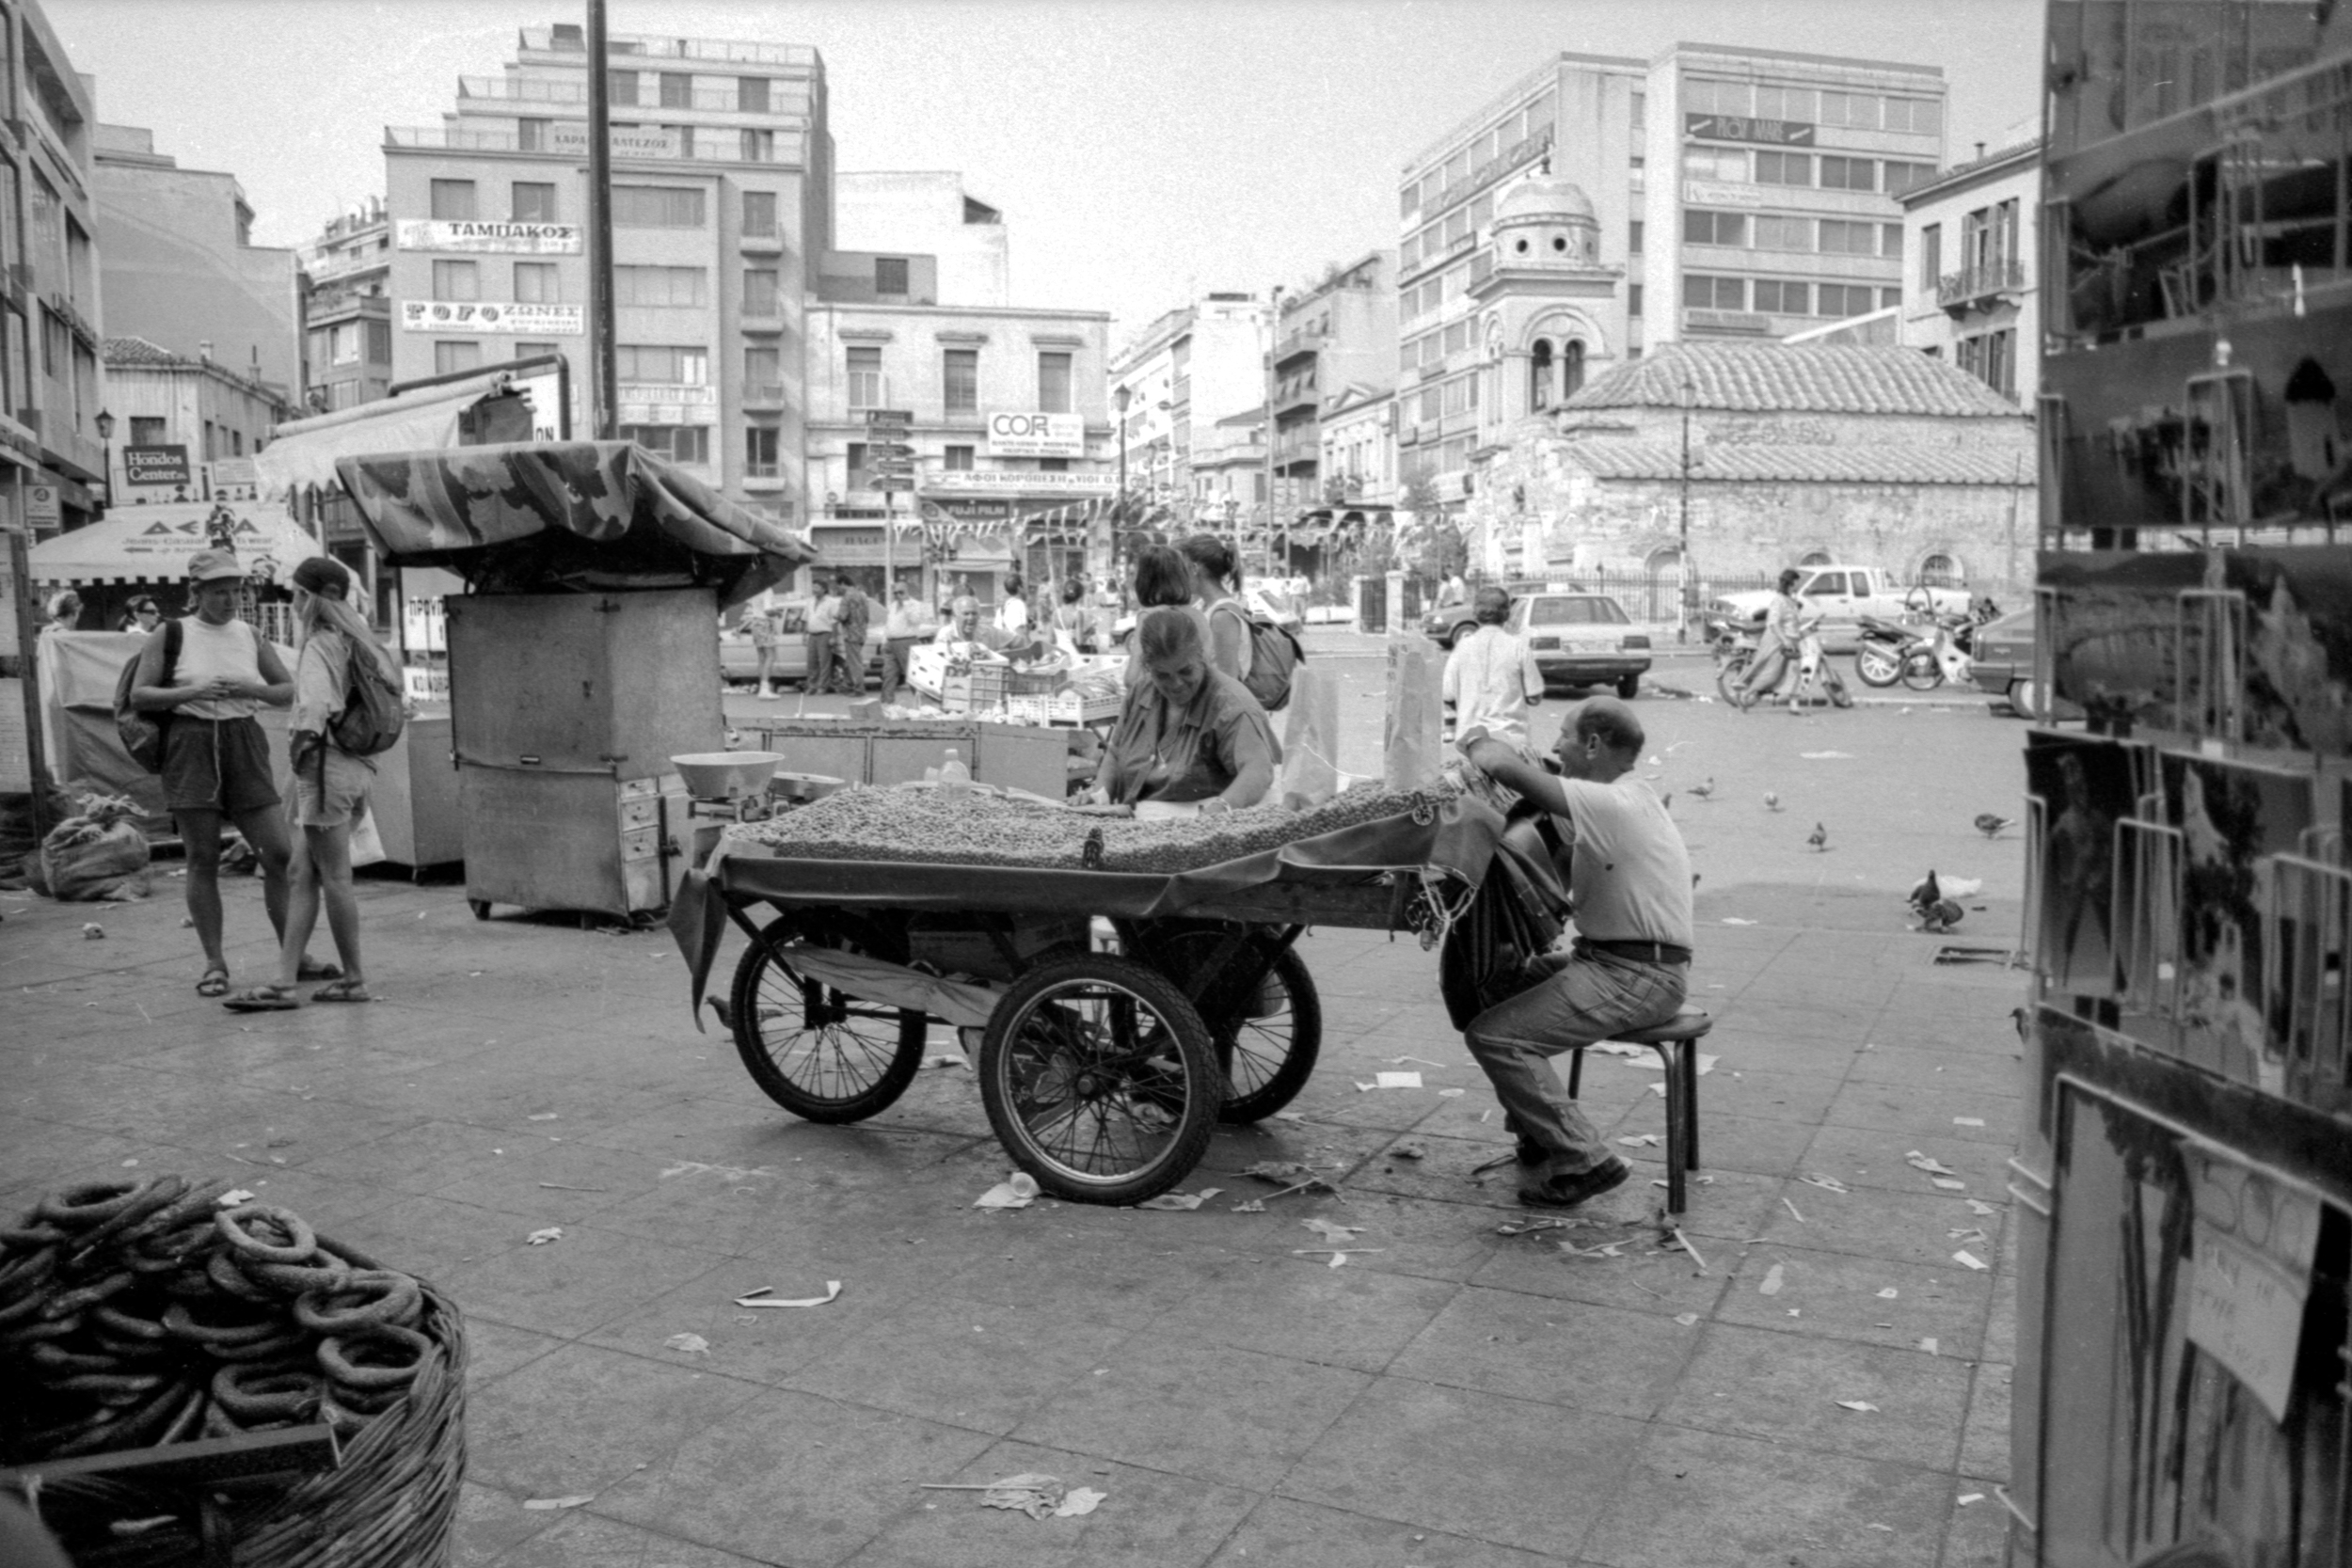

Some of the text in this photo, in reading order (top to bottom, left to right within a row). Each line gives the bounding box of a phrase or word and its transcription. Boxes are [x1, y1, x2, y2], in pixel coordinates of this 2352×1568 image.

[449, 222, 574, 239] ΤΑΜΠΑΚΟΣ
[503, 305, 580, 317] ΖΩΝΕΣ
[993, 414, 1050, 436] COR
[127, 451, 183, 466] Hondos
[129, 467, 177, 481] Center
[948, 505, 1006, 515] FUJI FILM
